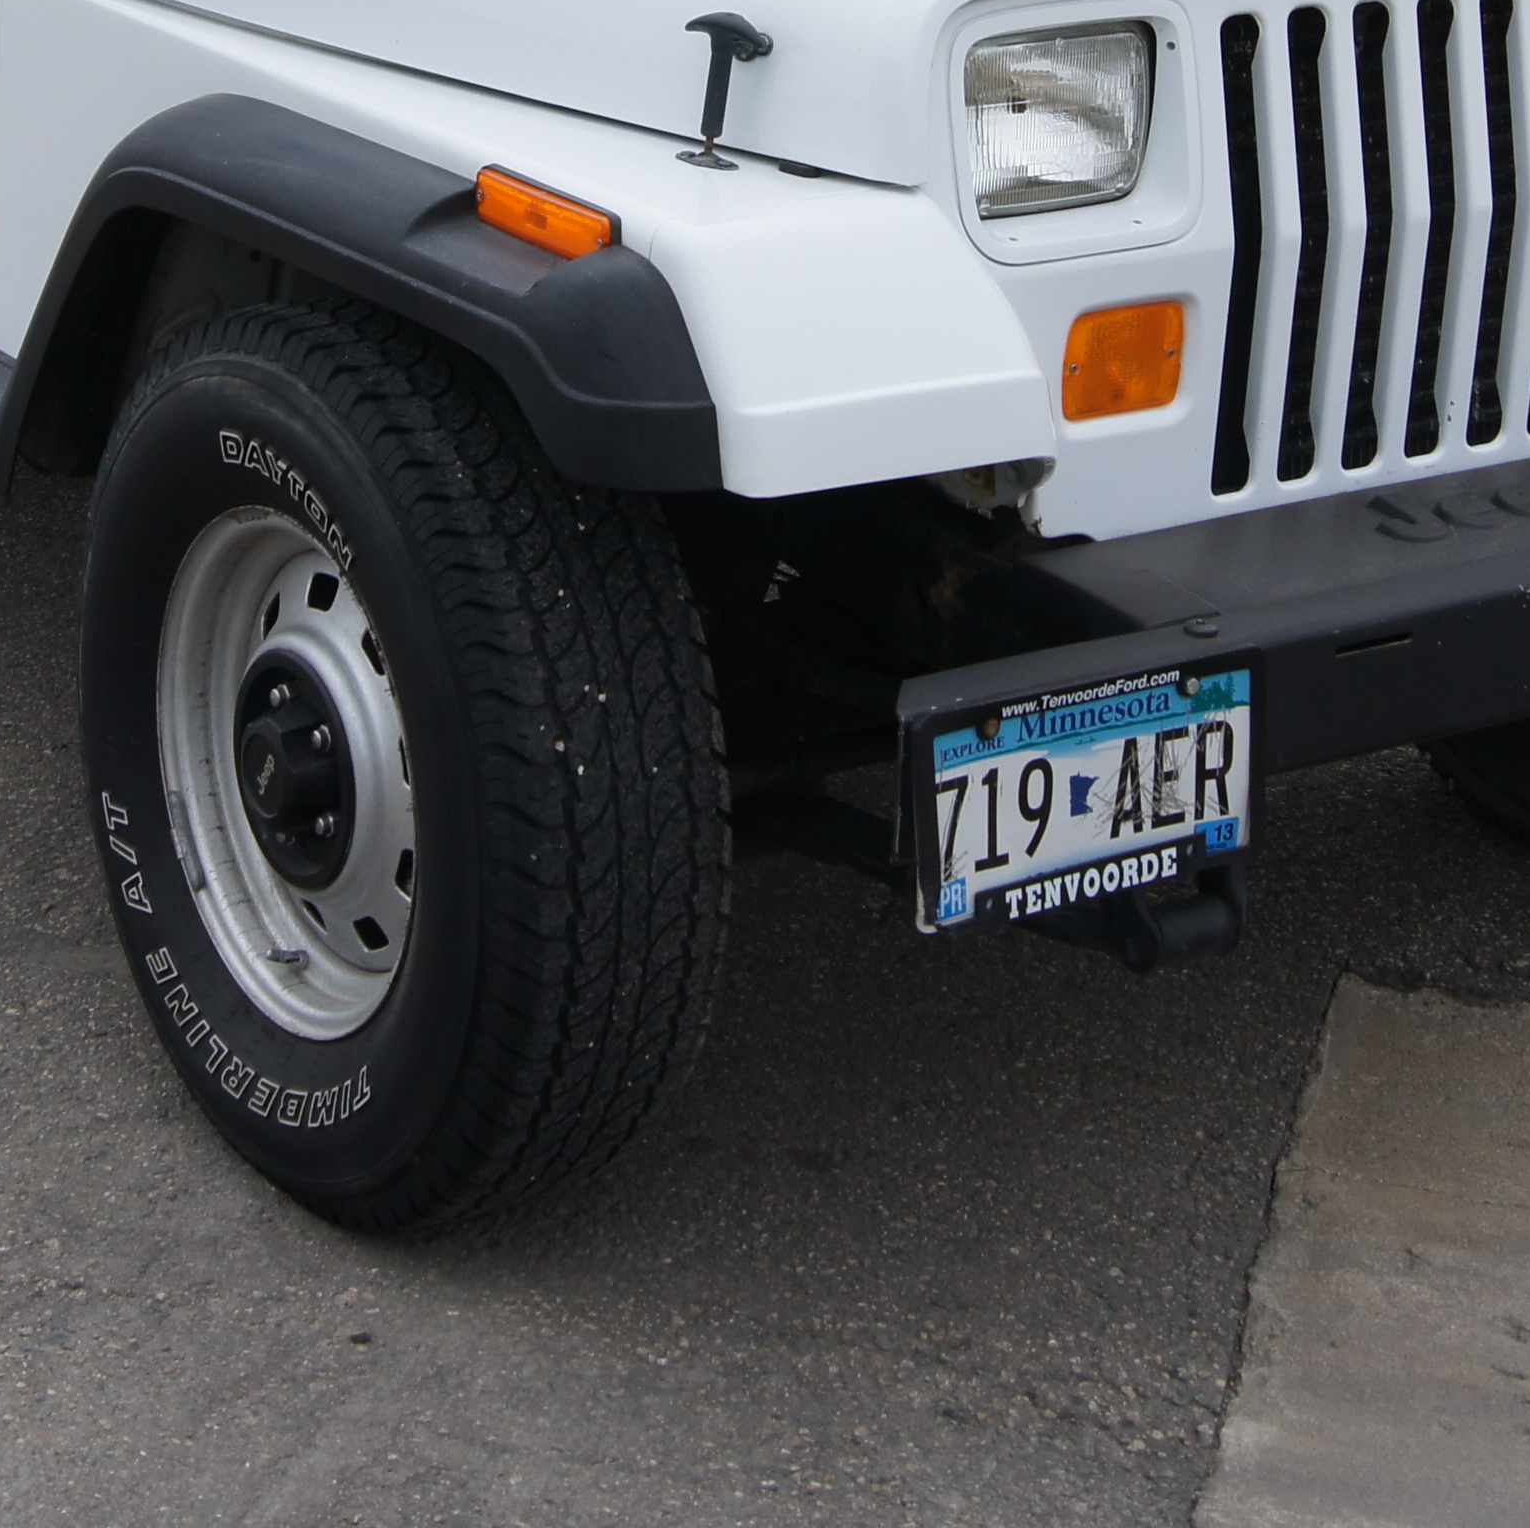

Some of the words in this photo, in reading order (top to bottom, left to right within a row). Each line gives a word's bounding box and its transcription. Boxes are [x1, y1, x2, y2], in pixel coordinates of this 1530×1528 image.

[218, 429, 354, 572] DAYTON
[942, 736, 1005, 762] EXPLORE
[1017, 691, 1171, 743] Minnesota
[1001, 669, 1181, 719] www.TenvoordeFord.com
[256, 753, 275, 796] Jeep
[935, 757, 1054, 884] 719
[1109, 719, 1235, 841] AER
[100, 792, 153, 916] A/T
[1214, 822, 1234, 843] 13
[1004, 846, 1179, 920] TENVOORDE
[145, 945, 373, 1129] TIMBERLINE
